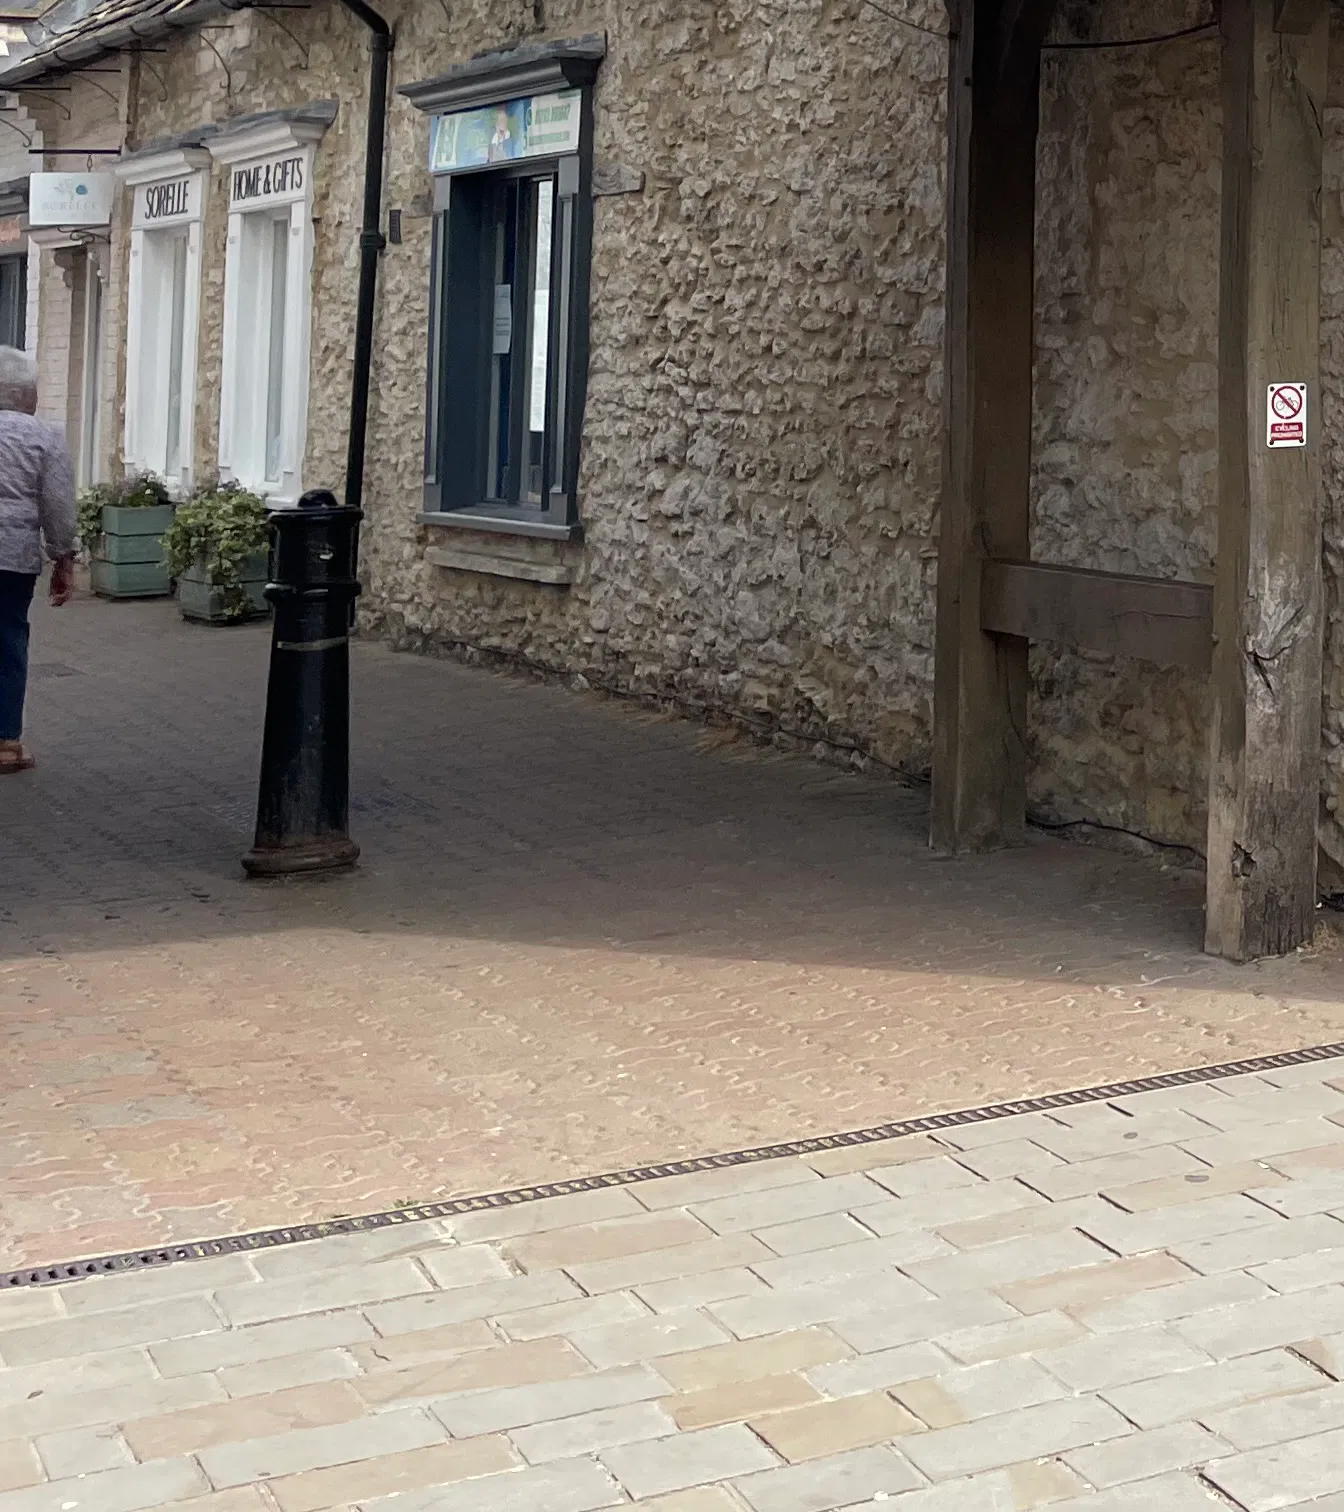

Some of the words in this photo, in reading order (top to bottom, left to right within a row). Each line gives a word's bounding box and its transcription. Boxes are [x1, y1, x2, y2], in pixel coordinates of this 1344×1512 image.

[144, 180, 190, 219] SORELLE
[232, 166, 262, 201] HOME
[263, 164, 271, 194] &
[272, 157, 303, 193] GIFTS
